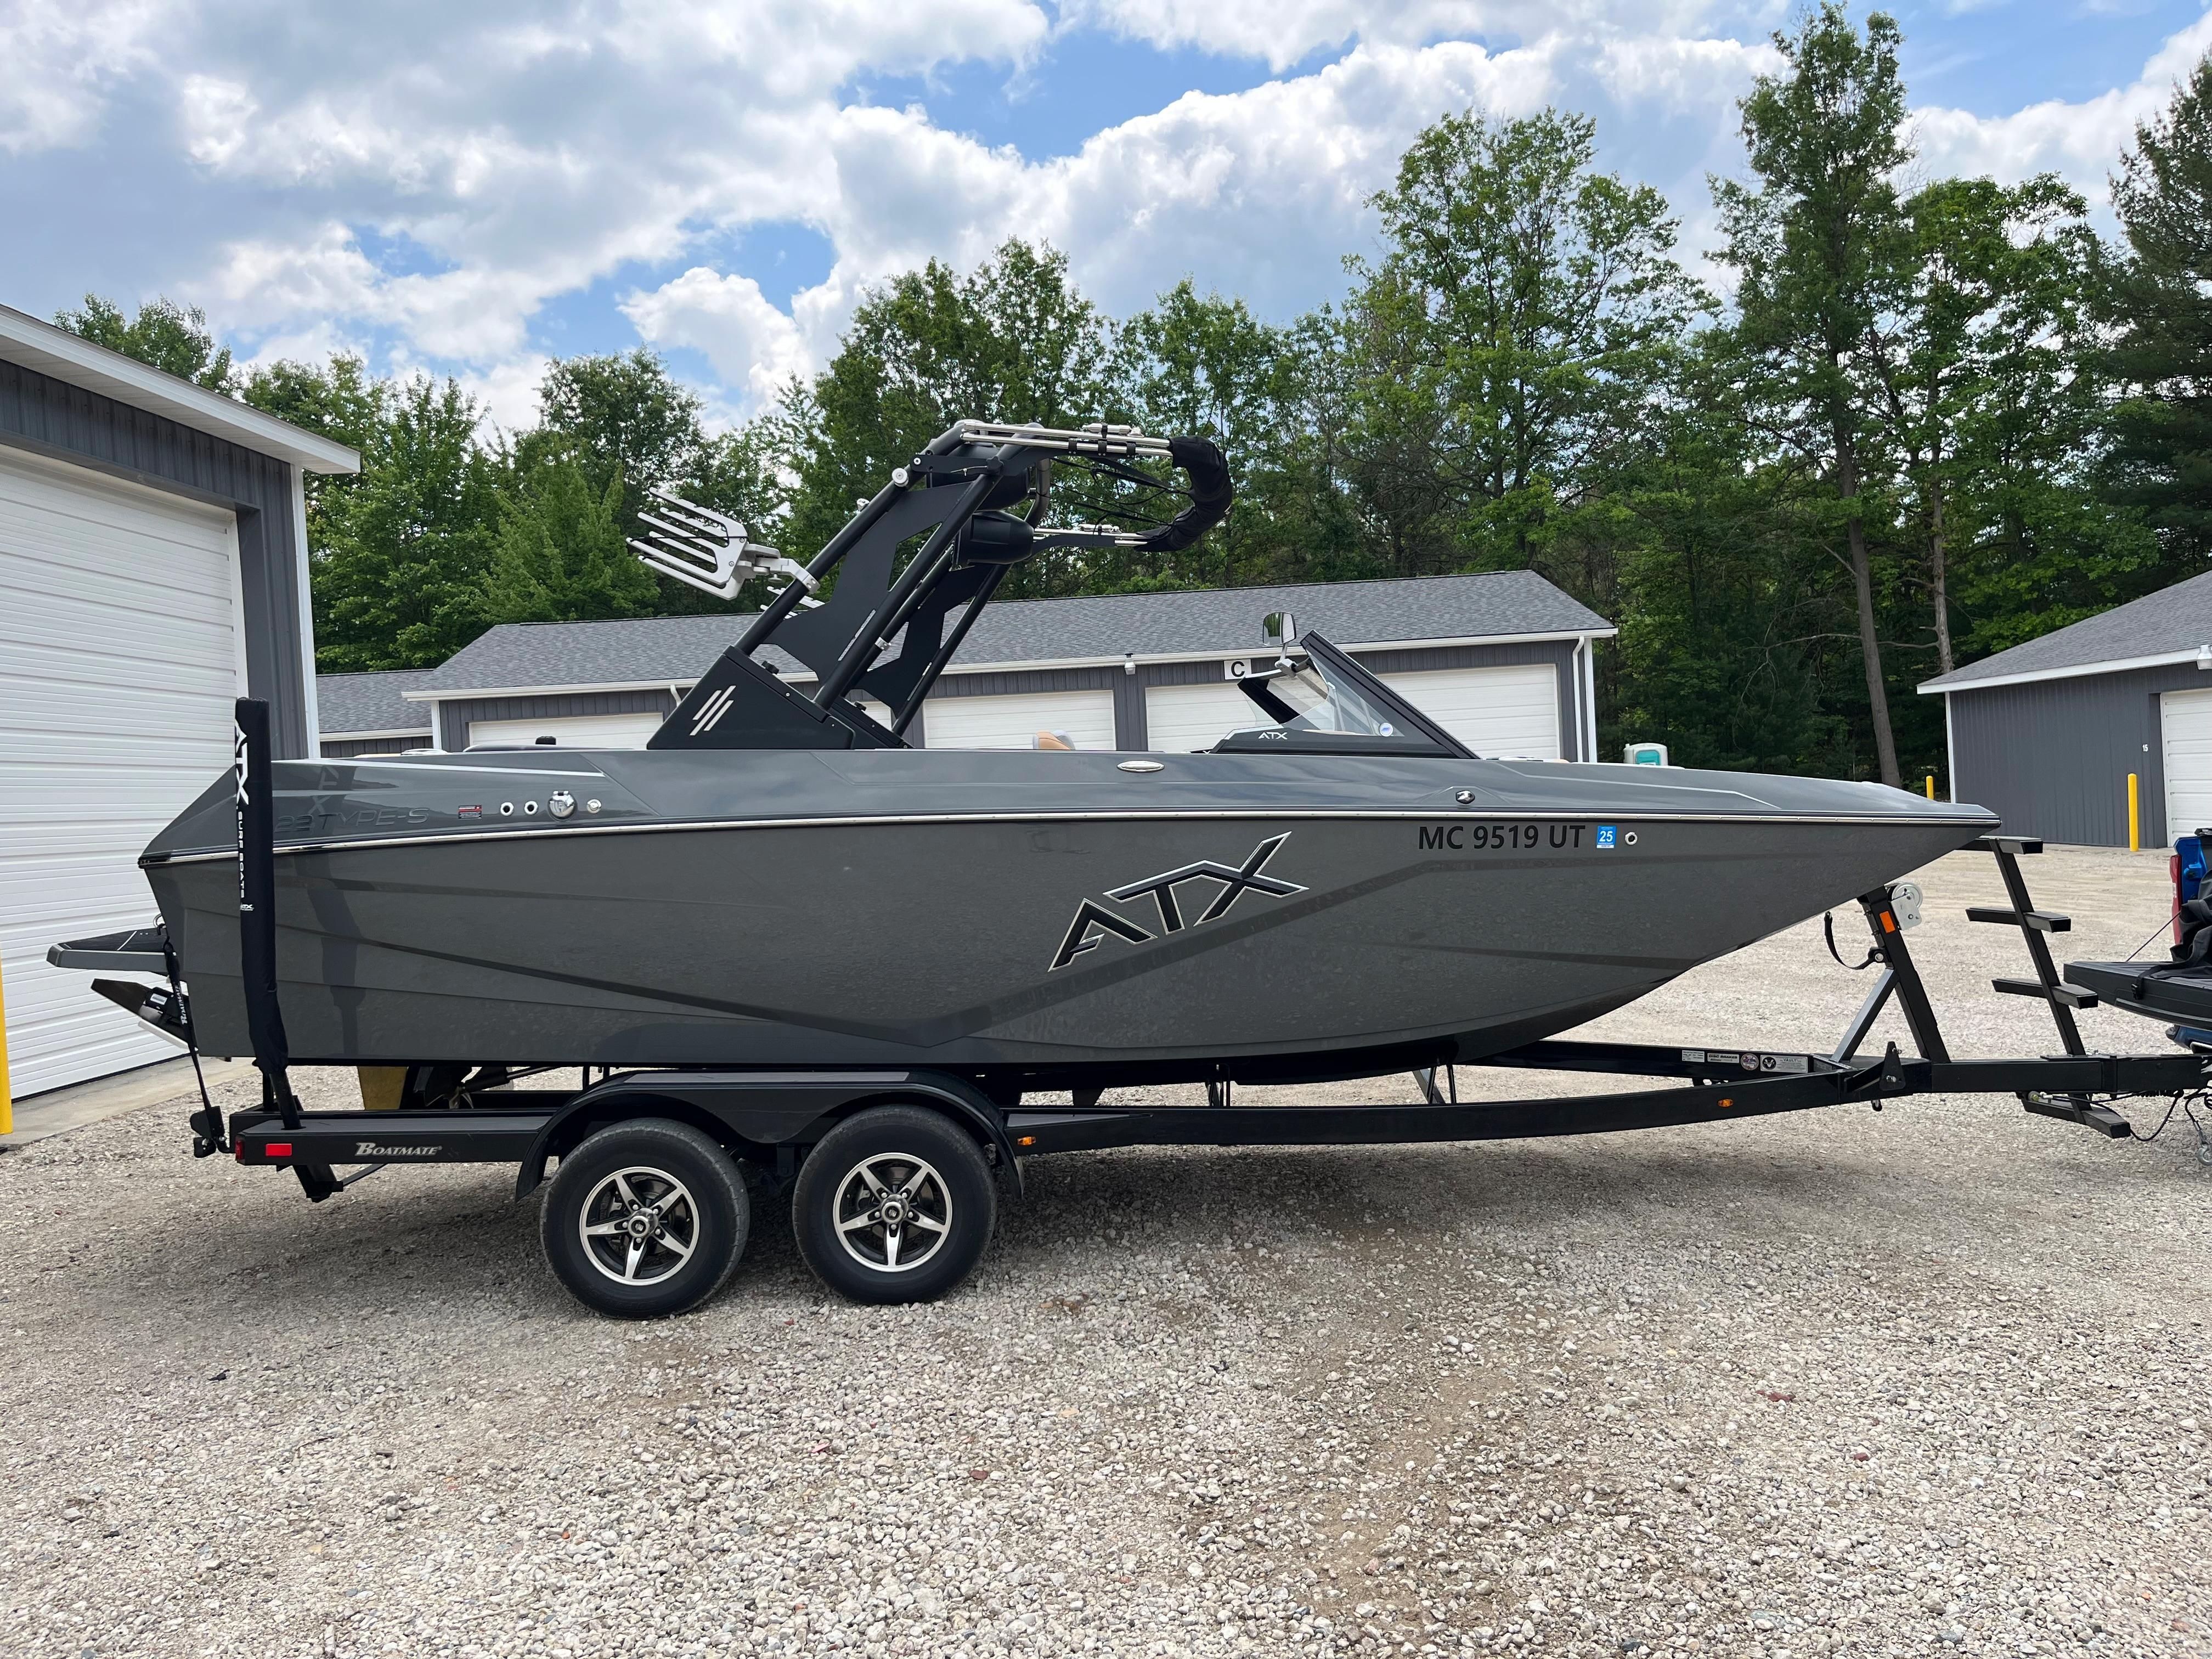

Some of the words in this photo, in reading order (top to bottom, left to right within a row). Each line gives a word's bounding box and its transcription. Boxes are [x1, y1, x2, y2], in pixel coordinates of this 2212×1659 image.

[1231, 661, 1245, 677] C
[1258, 731, 1288, 740] ATX
[319, 807, 430, 830] TYPE-S
[1419, 826, 1464, 850] MC
[1473, 825, 1539, 849] 9519
[1549, 825, 1585, 849] UT
[1599, 831, 1613, 842] 25
[1047, 831, 1310, 972] ATX
